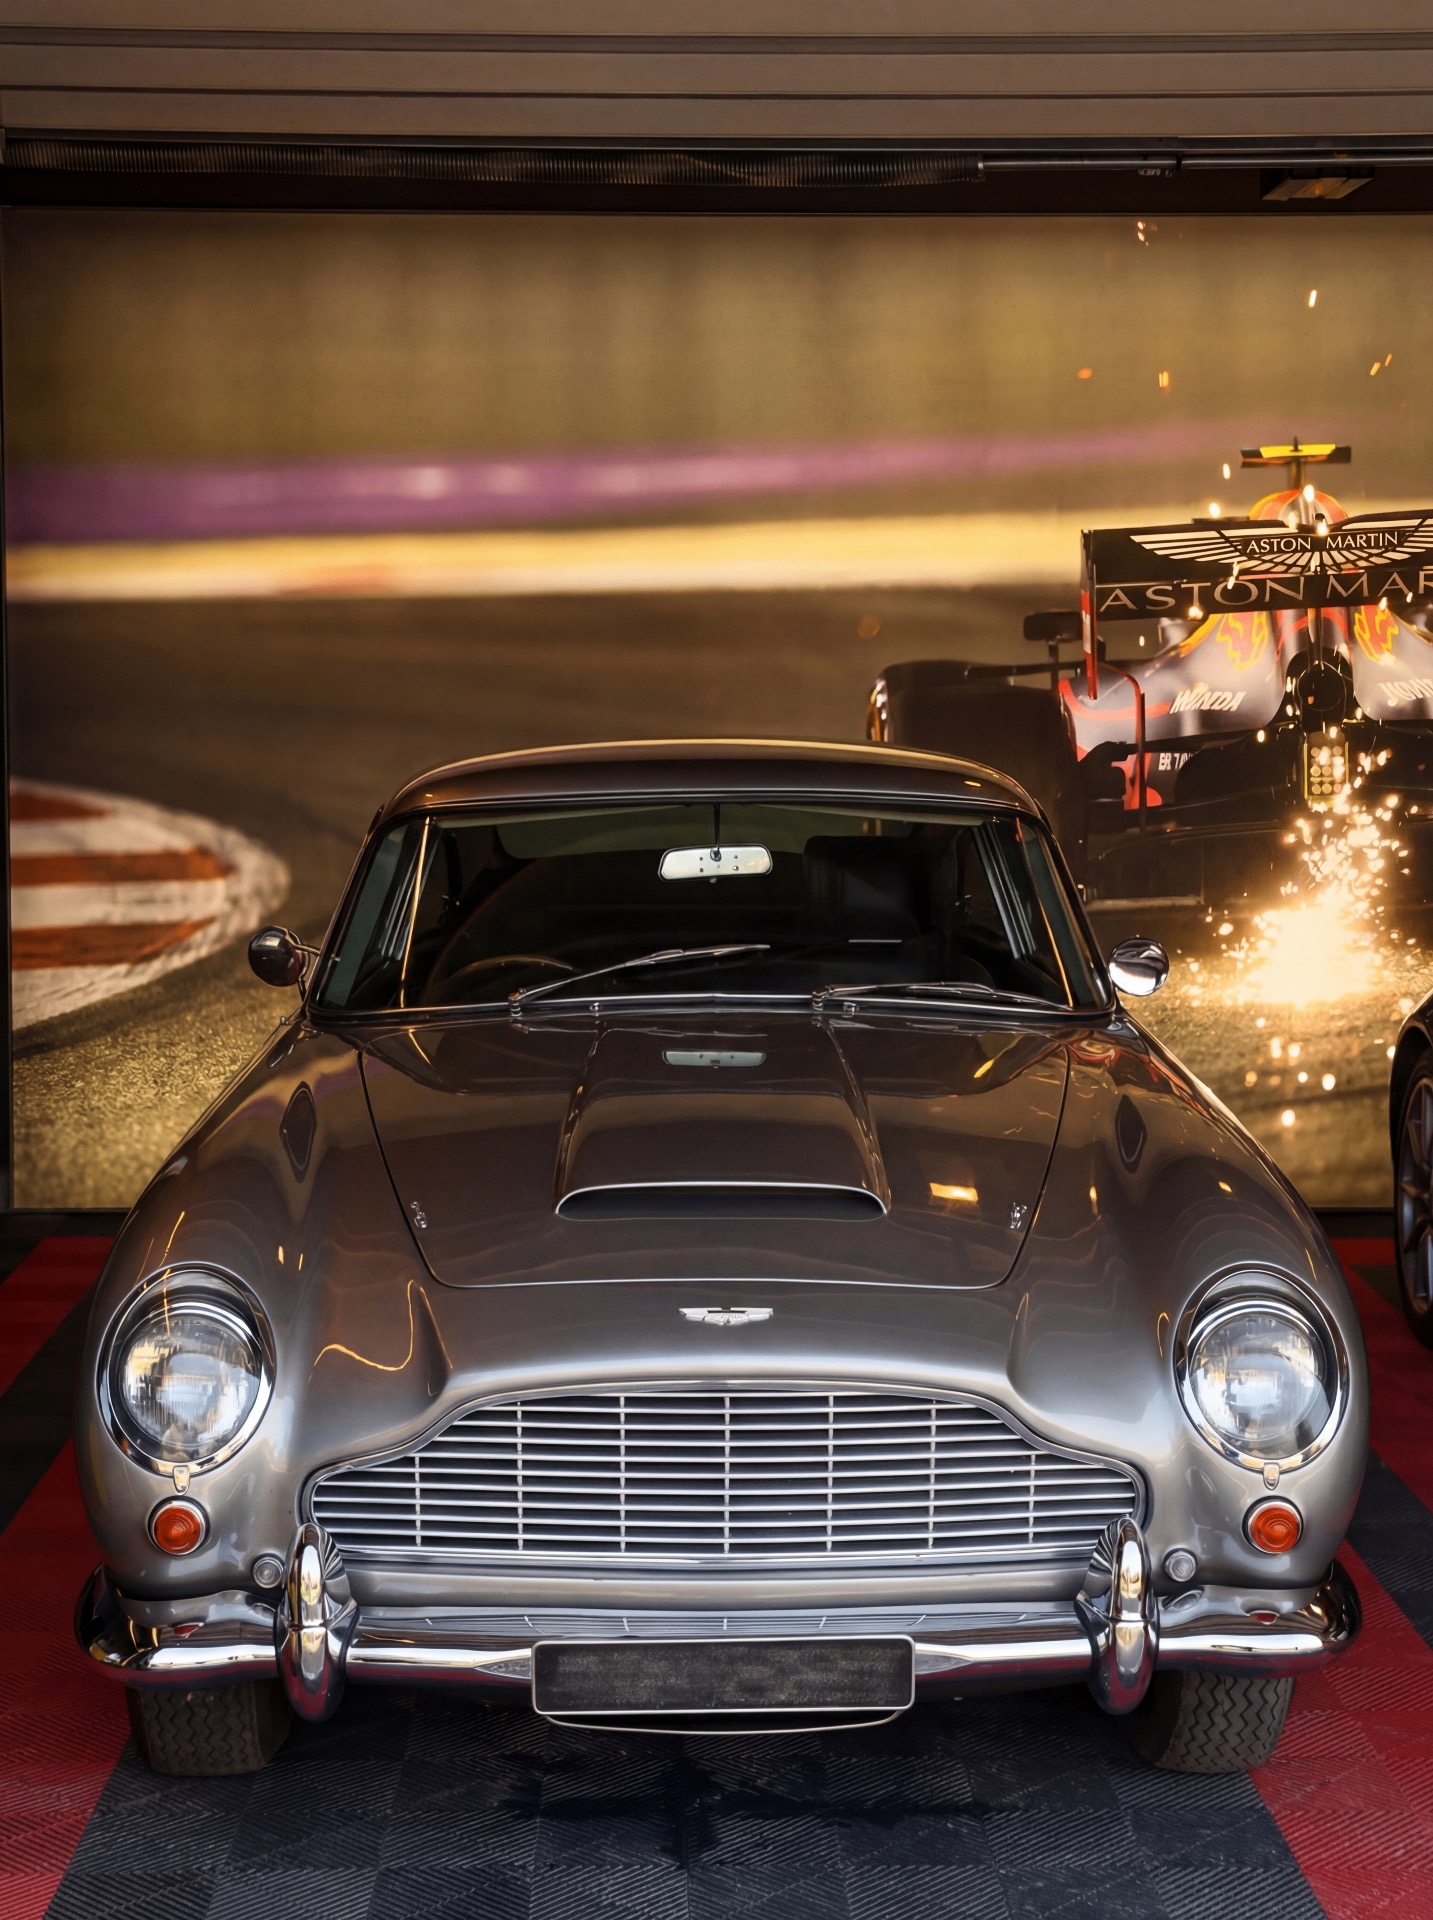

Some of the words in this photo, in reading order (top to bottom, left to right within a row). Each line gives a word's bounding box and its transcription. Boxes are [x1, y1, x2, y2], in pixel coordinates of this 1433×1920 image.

[1246, 537, 1312, 553] ASTON
[1326, 531, 1398, 549] MARTIN
[1099, 576, 1306, 613] ASTON
